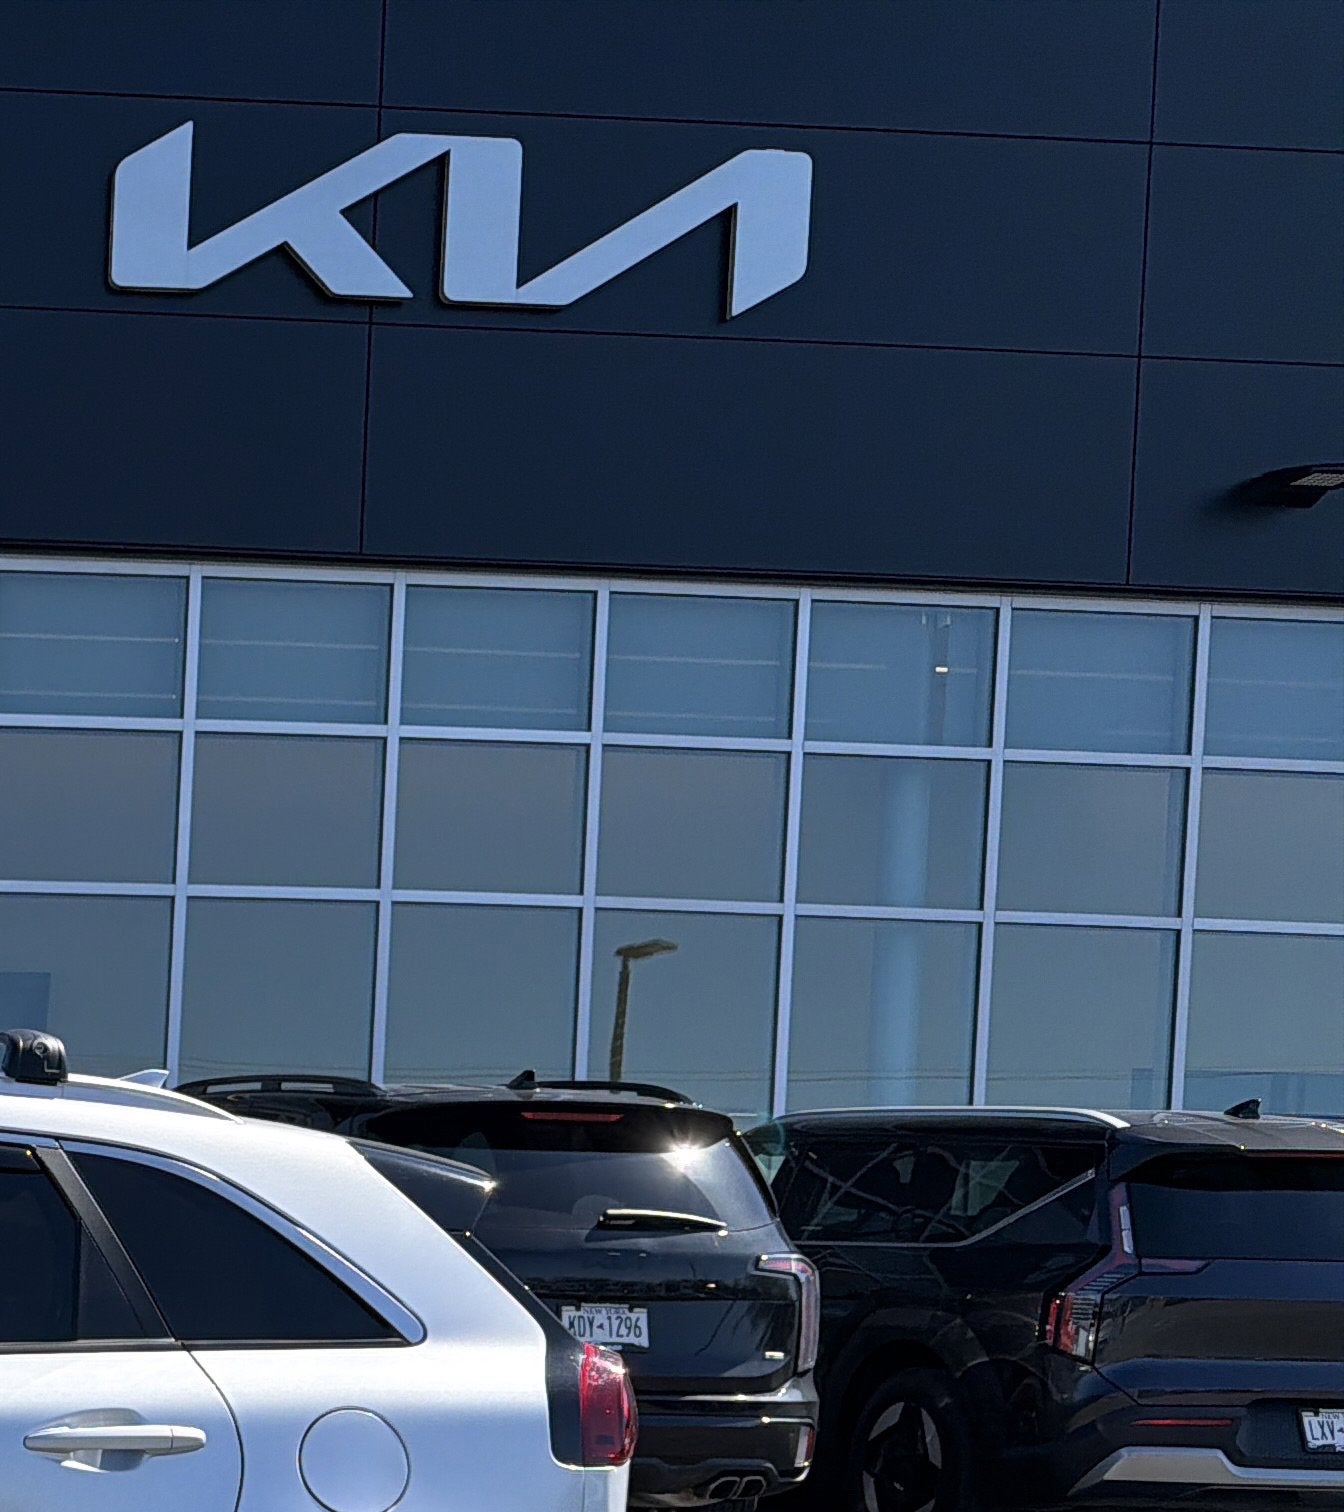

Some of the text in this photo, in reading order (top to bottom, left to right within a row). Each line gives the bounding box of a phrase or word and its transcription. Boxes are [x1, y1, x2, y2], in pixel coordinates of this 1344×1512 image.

[111, 120, 813, 320] KIA
[606, 1315, 642, 1339] 1296
[1307, 1419, 1336, 1441] LXV
